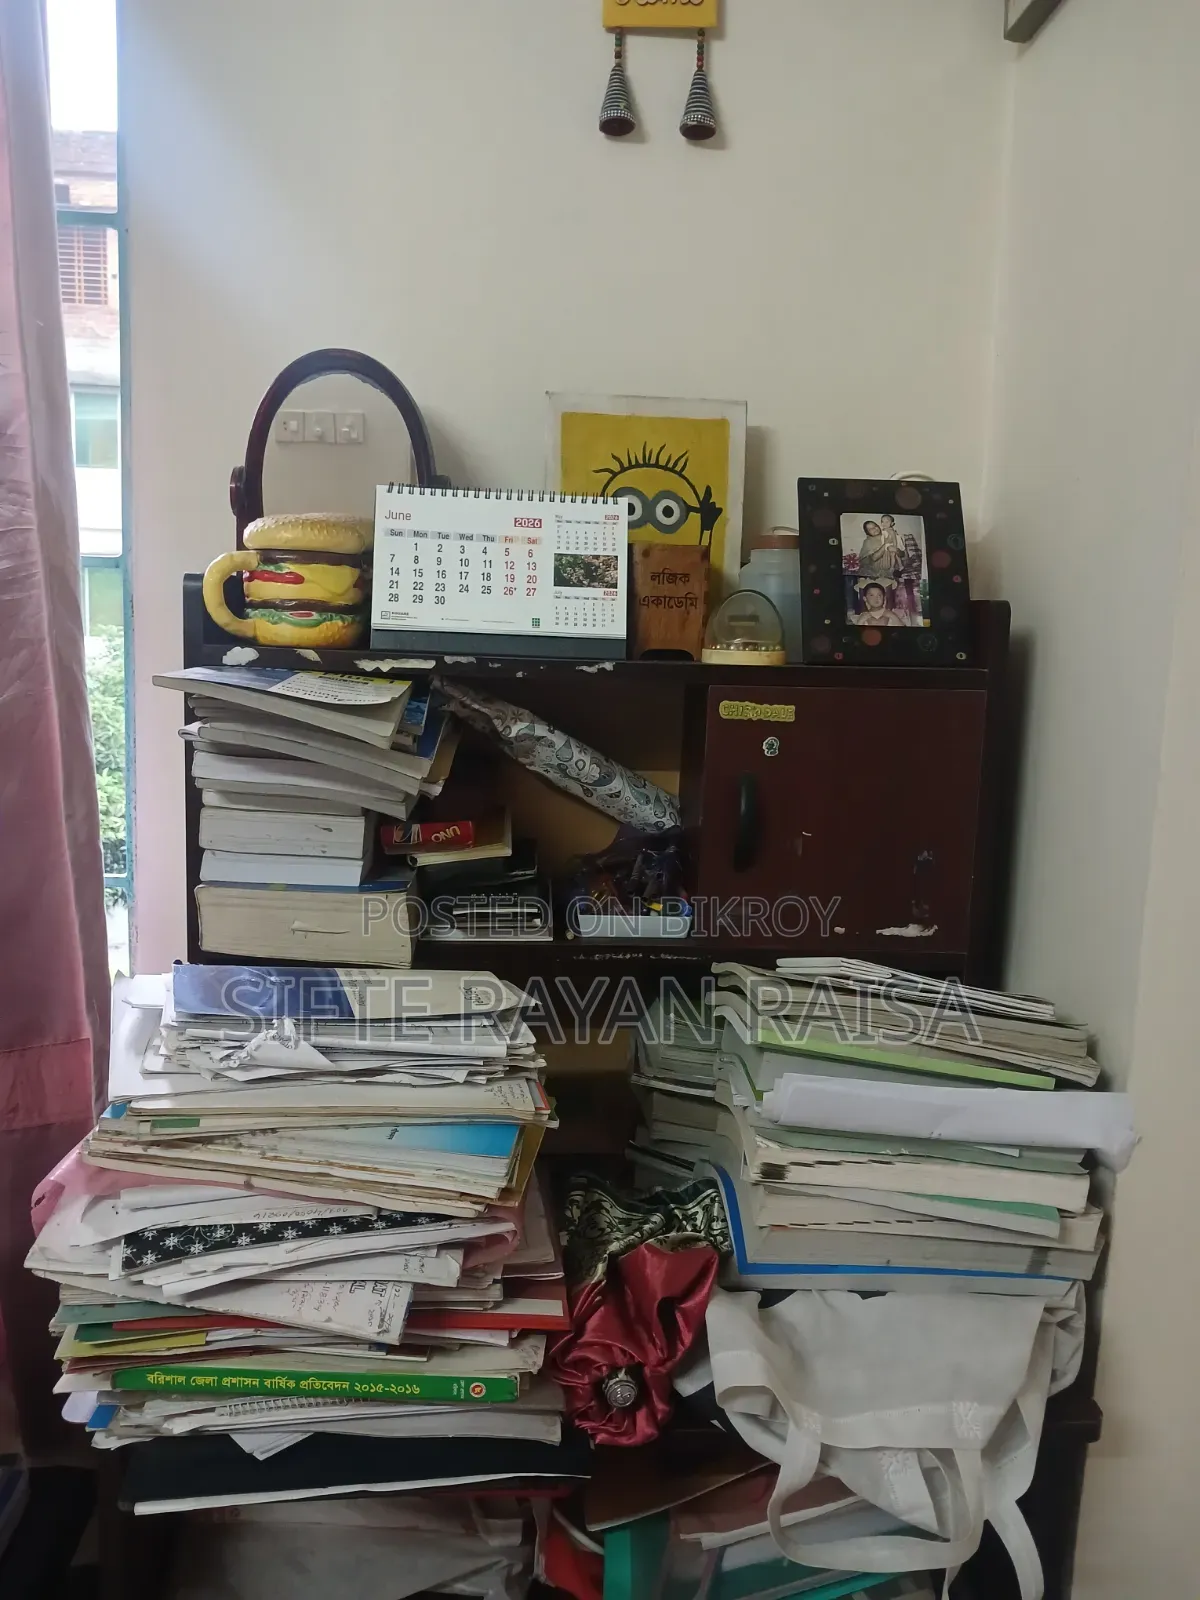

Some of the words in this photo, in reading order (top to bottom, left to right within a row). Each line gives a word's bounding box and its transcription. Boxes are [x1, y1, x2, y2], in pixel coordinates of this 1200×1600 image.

[384, 509, 412, 521] June
[515, 518, 541, 528] 2026
[390, 529, 403, 537] Sun
[437, 532, 450, 540] Tue
[458, 533, 474, 541] Wed
[482, 534, 495, 542] Thu
[413, 542, 418, 551] 1
[437, 543, 443, 553] 2
[459, 545, 466, 554] 3
[482, 546, 488, 556] 4
[504, 547, 510, 557] 5
[527, 548, 534, 558] 6
[389, 553, 396, 563] 7
[413, 555, 420, 565] 8
[436, 556, 442, 566] 9
[458, 558, 470, 568] 10
[482, 559, 492, 569] 11
[504, 560, 515, 570] 12
[526, 561, 537, 571] 13
[389, 566, 400, 577] 14
[412, 568, 424, 578] 15
[436, 569, 447, 579] 16
[458, 571, 470, 581] 17
[480, 572, 492, 582] 18
[504, 573, 516, 583] 19
[526, 574, 538, 584] 20
[650, 567, 690, 586] লজিক
[388, 579, 399, 590] 21
[412, 581, 424, 591] 22
[434, 582, 446, 592] 23
[458, 583, 470, 594] 24
[480, 585, 492, 595] 25
[525, 587, 537, 597] 27
[387, 592, 400, 603] 28
[412, 594, 424, 604] 29
[434, 595, 446, 605] 30
[639, 592, 698, 610] একাডেমি
[431, 825, 460, 842] UNO
[146, 1371, 186, 1386] বরিশাল
[190, 1375, 218, 1387] জেলা
[221, 1376, 260, 1388] প্রশাসন
[263, 1375, 296, 1390] বার্ষিক
[299, 1376, 350, 1391] প্রতিবেদন
[354, 1381, 421, 1395] ২০১৫-২০১৬
